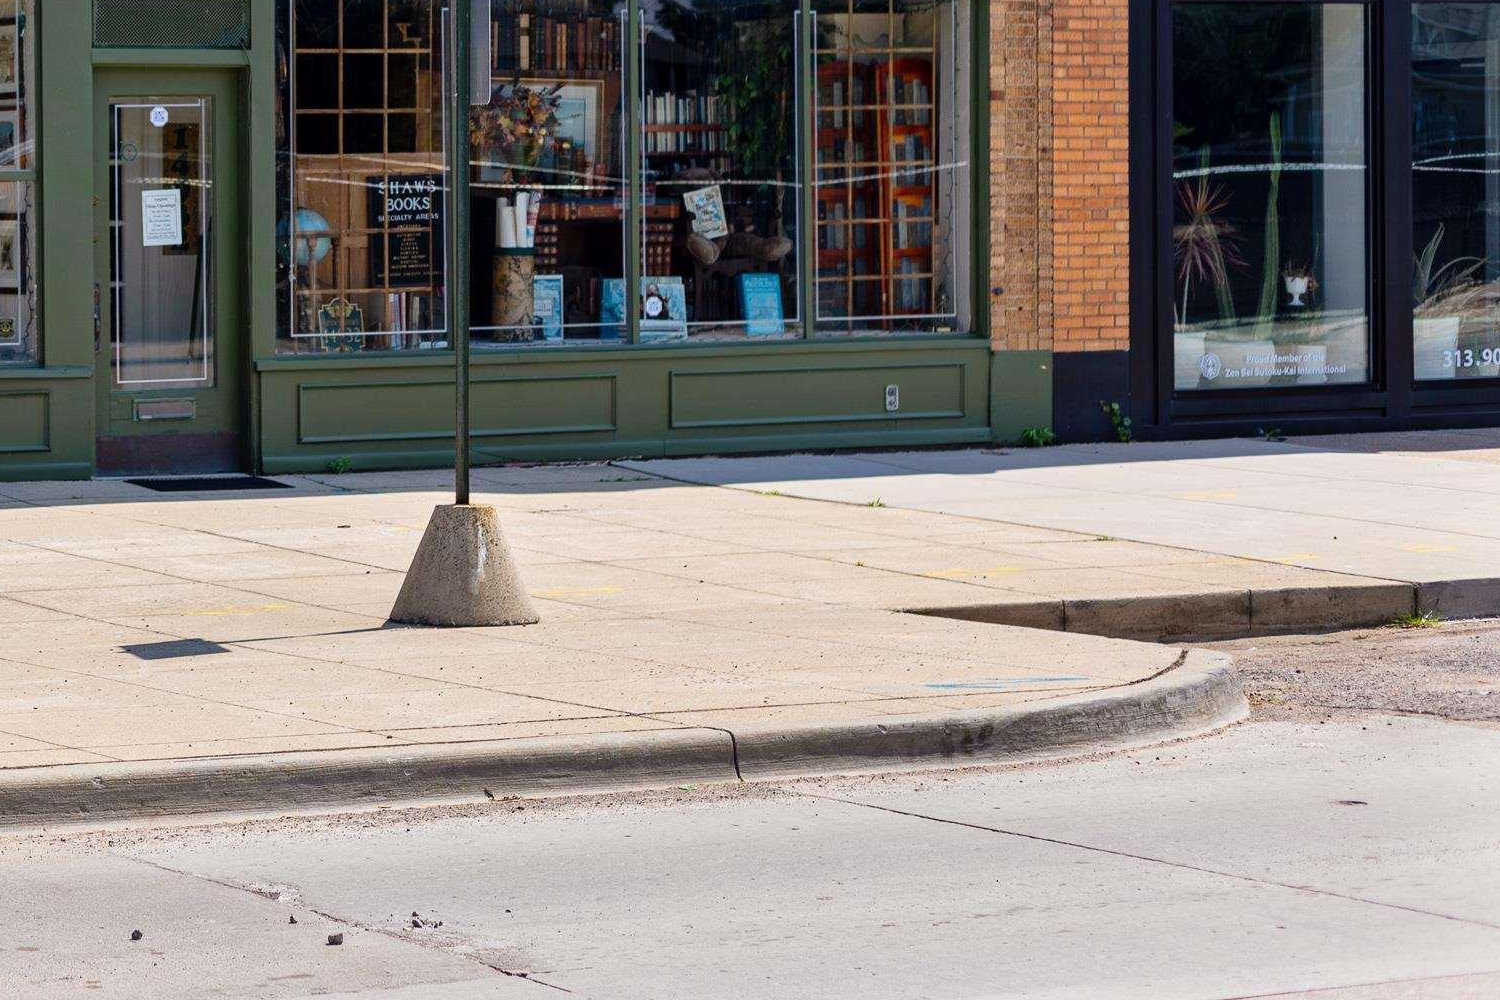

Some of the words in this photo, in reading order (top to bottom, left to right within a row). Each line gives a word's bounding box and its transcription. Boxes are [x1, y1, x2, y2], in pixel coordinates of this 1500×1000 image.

[386, 197, 431, 212] BOOKS
[1271, 352, 1302, 363] Member
[1303, 352, 1311, 362] of
[1297, 364, 1346, 376] International
